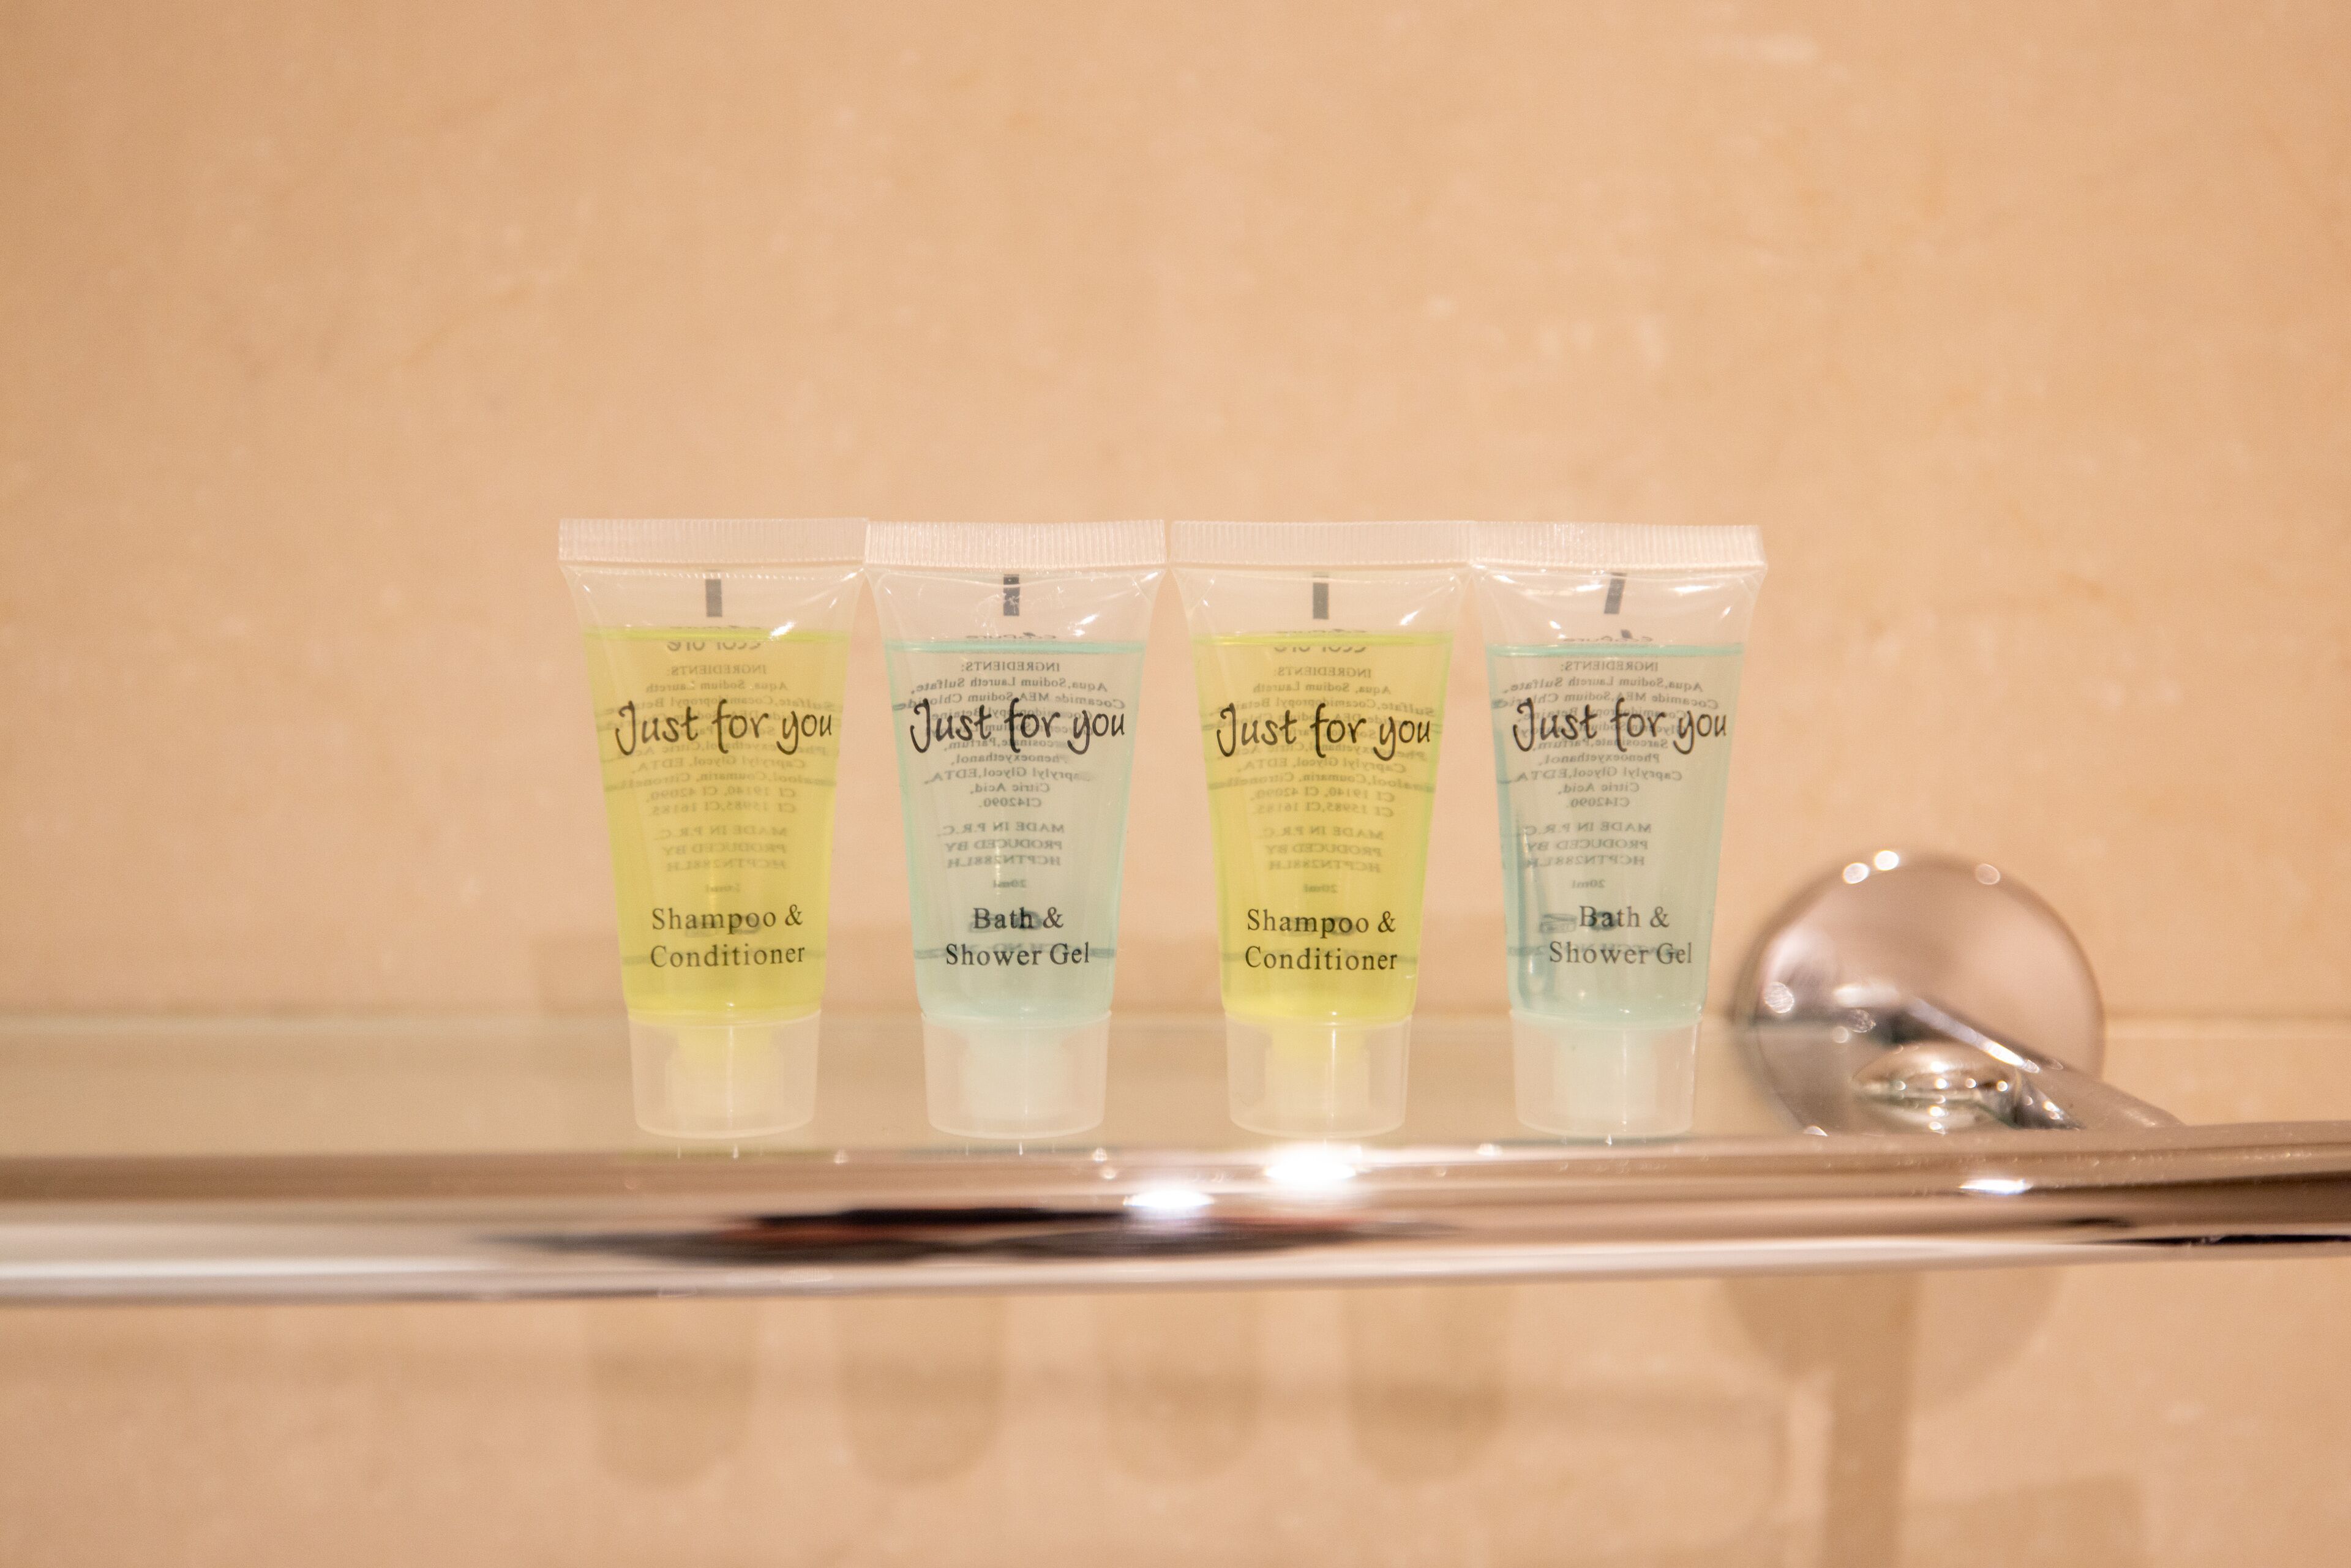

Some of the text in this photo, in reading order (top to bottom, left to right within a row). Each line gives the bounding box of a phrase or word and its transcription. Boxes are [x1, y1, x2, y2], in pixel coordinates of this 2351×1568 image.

[616, 699, 831, 756] Just for you
[910, 697, 1125, 755] Just for you
[1217, 703, 1430, 761] Just for you
[1513, 697, 1727, 755] Just for you
[652, 904, 803, 934] Shampoo &
[973, 907, 1064, 929] Bath &
[1247, 909, 1396, 939] Shampoo &
[1579, 906, 1670, 928] Bath &
[650, 944, 804, 967] Conditioner
[946, 943, 1042, 966] Shower
[1050, 942, 1089, 965] Gel
[1245, 946, 1397, 970] Conditioner
[1550, 941, 1649, 964] Shower
[1657, 942, 1692, 964] Gel
